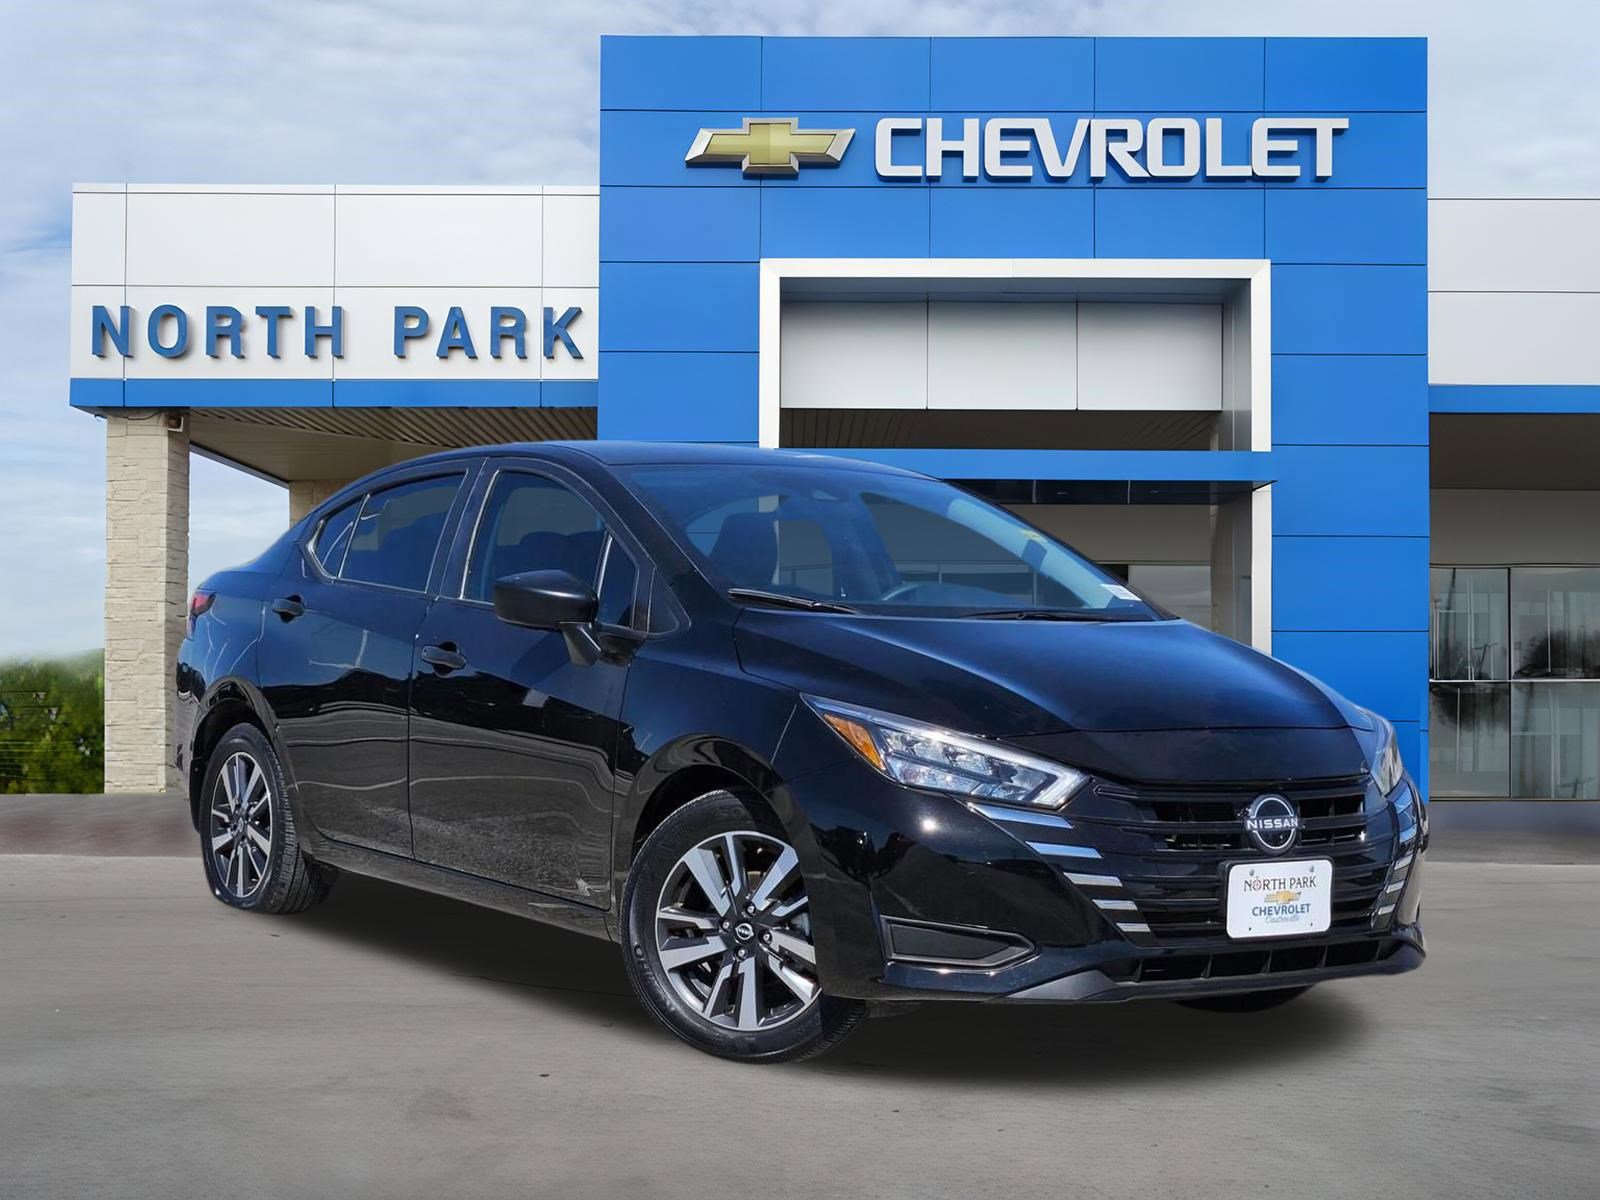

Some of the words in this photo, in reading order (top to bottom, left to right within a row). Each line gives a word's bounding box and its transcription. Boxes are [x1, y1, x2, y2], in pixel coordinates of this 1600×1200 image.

[875, 117, 1349, 180] CHEVROLET
[91, 304, 346, 360] NORTH
[394, 305, 585, 361] PARK
[1246, 817, 1298, 830] NISSAN
[1244, 877, 1286, 892] NORTH
[1289, 876, 1317, 889] PARK
[1252, 903, 1311, 916] CHEVROLET
